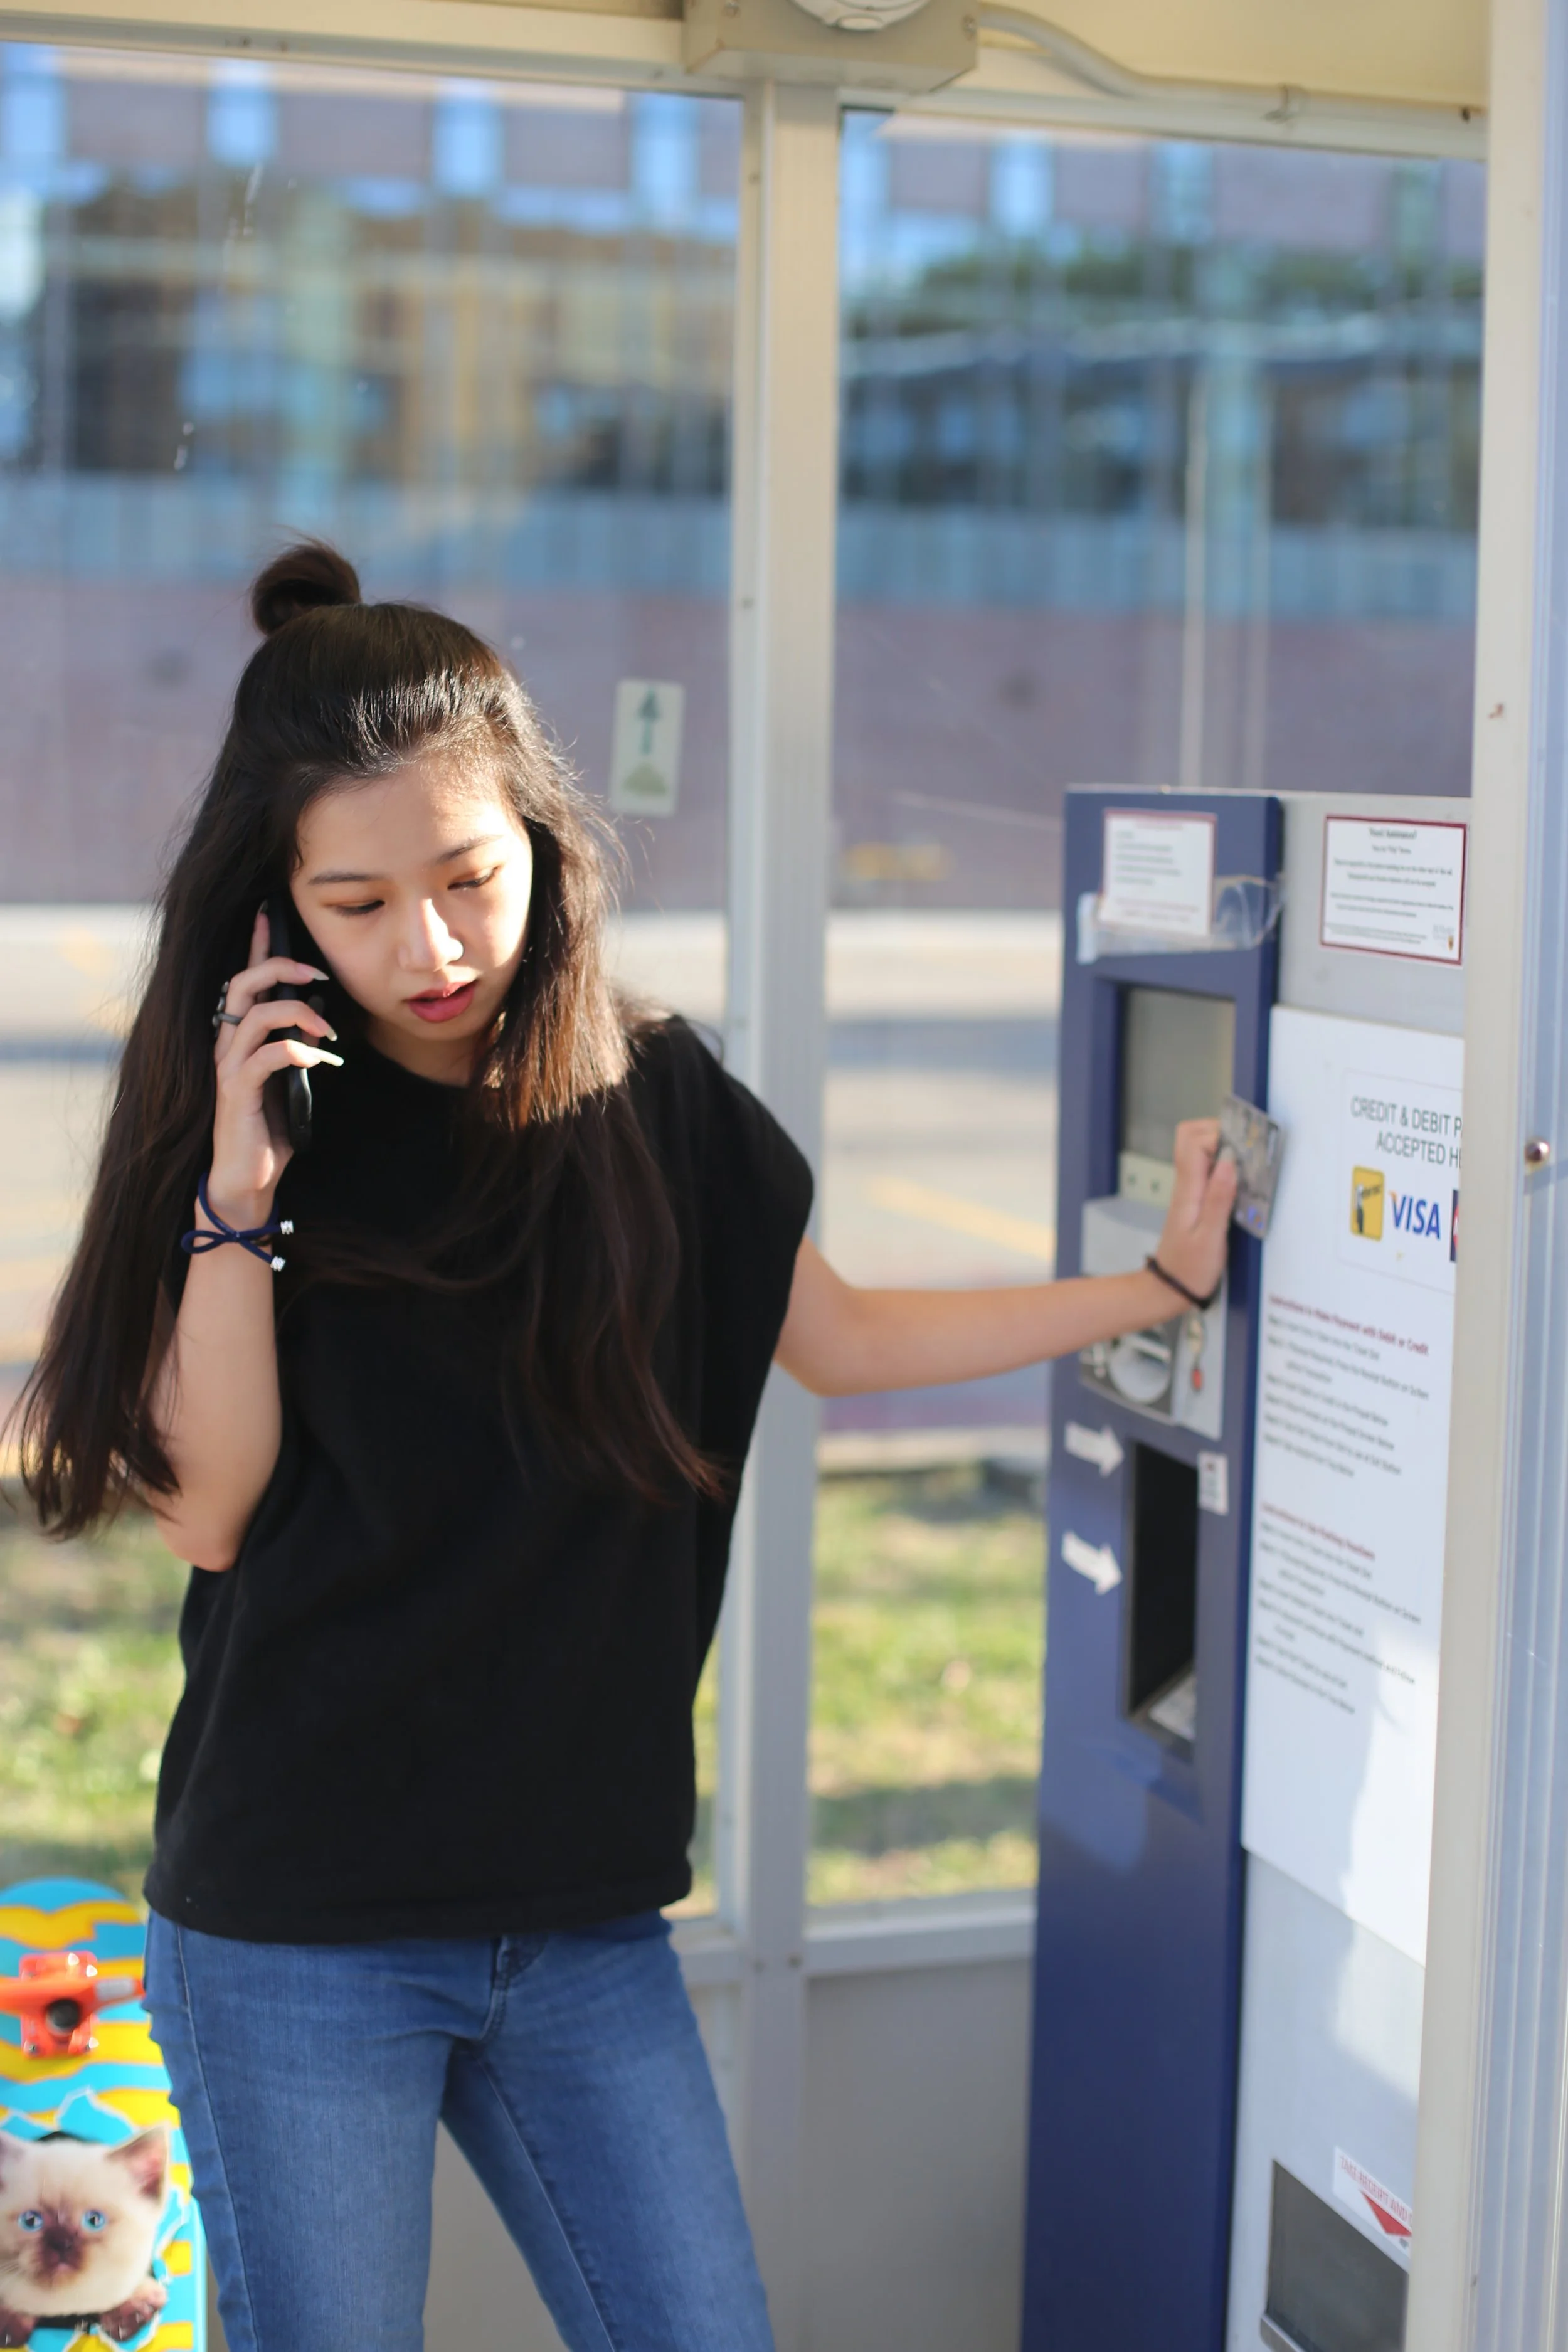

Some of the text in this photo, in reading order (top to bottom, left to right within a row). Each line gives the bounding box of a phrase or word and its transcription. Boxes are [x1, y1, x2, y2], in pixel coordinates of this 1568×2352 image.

[1350, 1094, 1463, 1138] CREDIT & DEBIT P
[1375, 1130, 1461, 1169] ACCEPTED H
[1388, 1190, 1441, 1240] VISA
